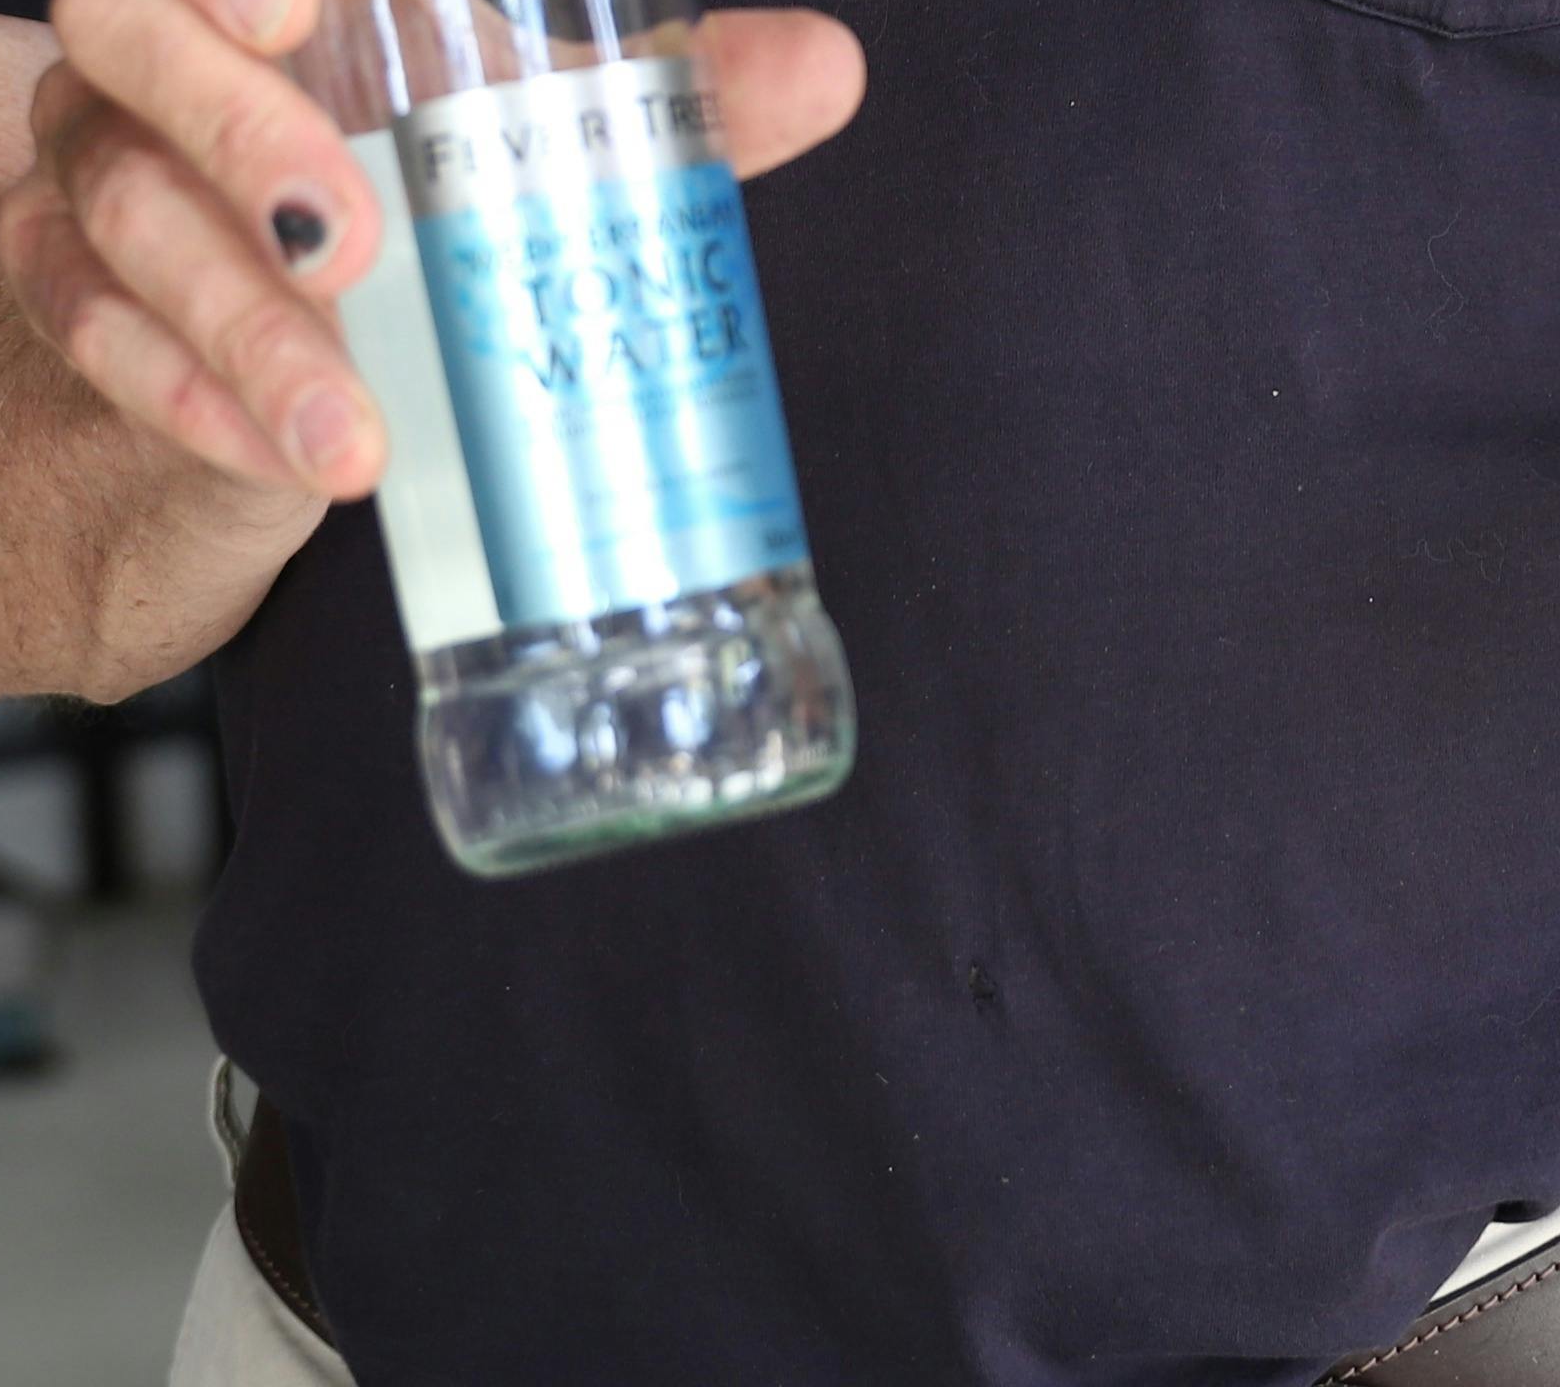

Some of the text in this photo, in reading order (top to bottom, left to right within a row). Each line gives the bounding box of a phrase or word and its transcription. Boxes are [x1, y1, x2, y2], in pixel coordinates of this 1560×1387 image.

[423, 108, 614, 184] FVR
[524, 239, 729, 327] TONIC
[517, 303, 750, 390] WATER
